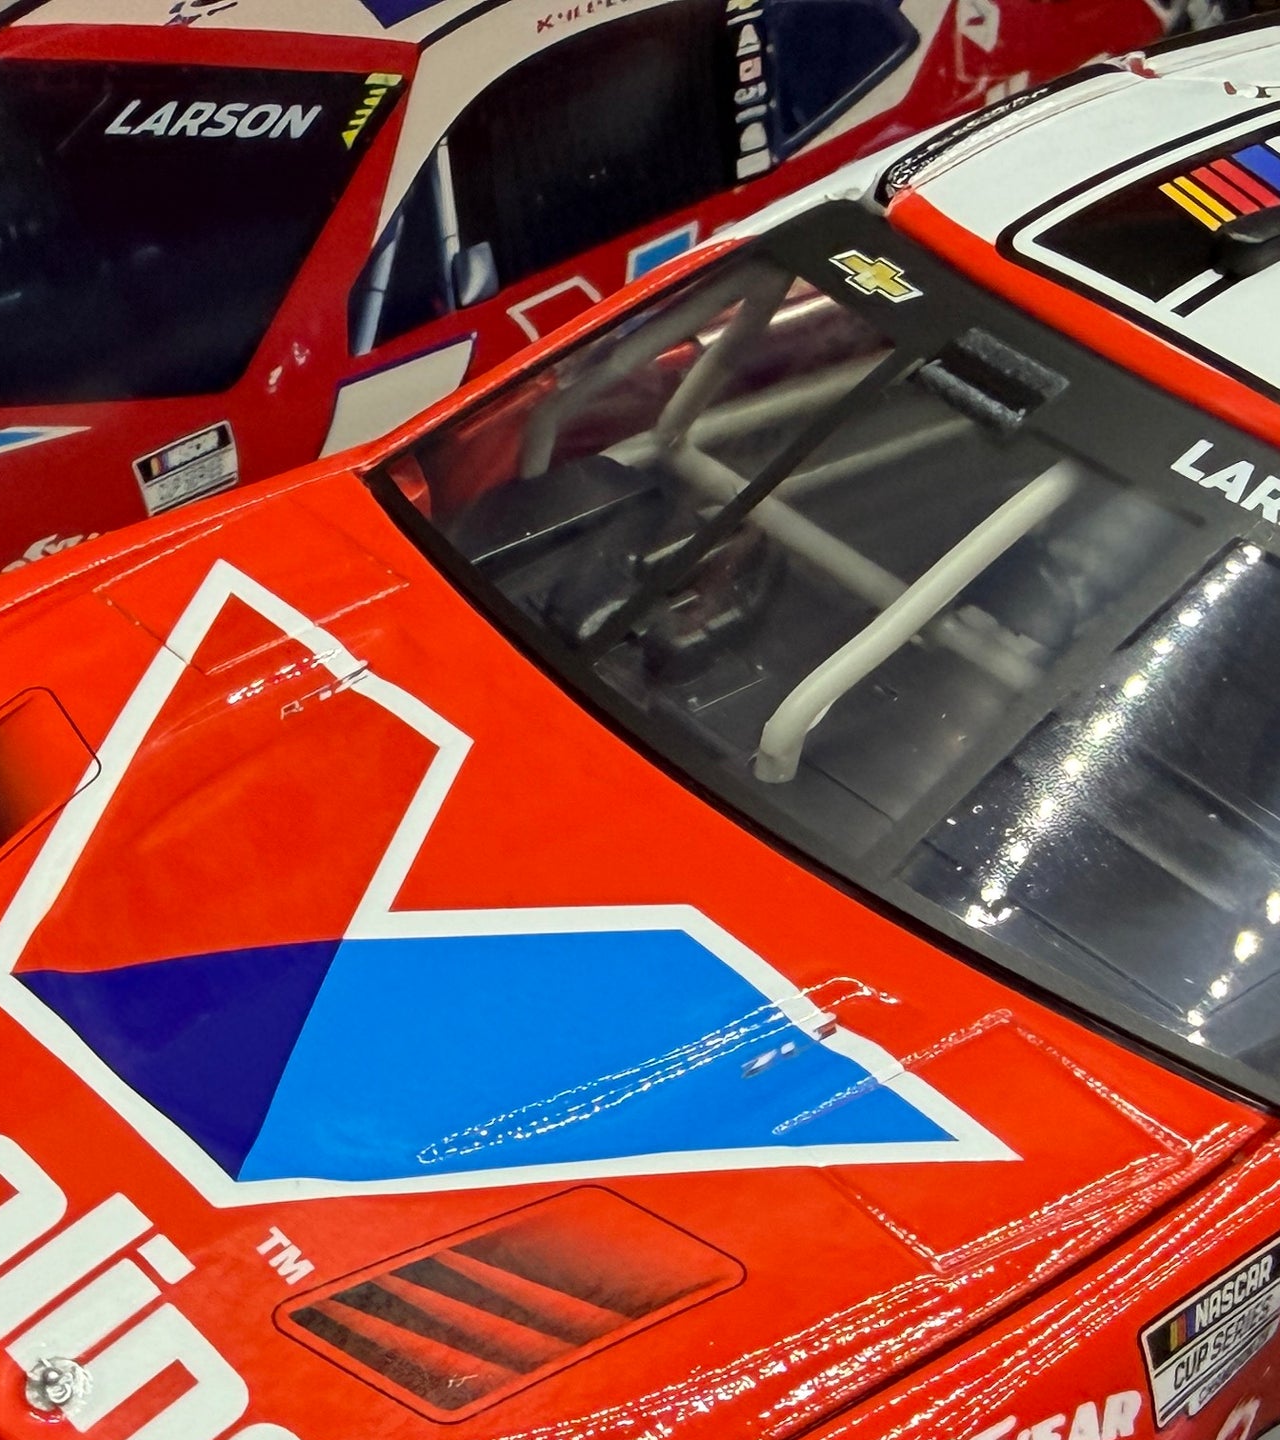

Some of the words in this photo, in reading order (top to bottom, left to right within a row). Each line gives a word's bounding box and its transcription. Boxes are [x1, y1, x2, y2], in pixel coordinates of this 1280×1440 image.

[104, 100, 323, 140] LARSON
[1194, 1254, 1274, 1334] NASCAR
[1173, 1348, 1207, 1392] CUP
